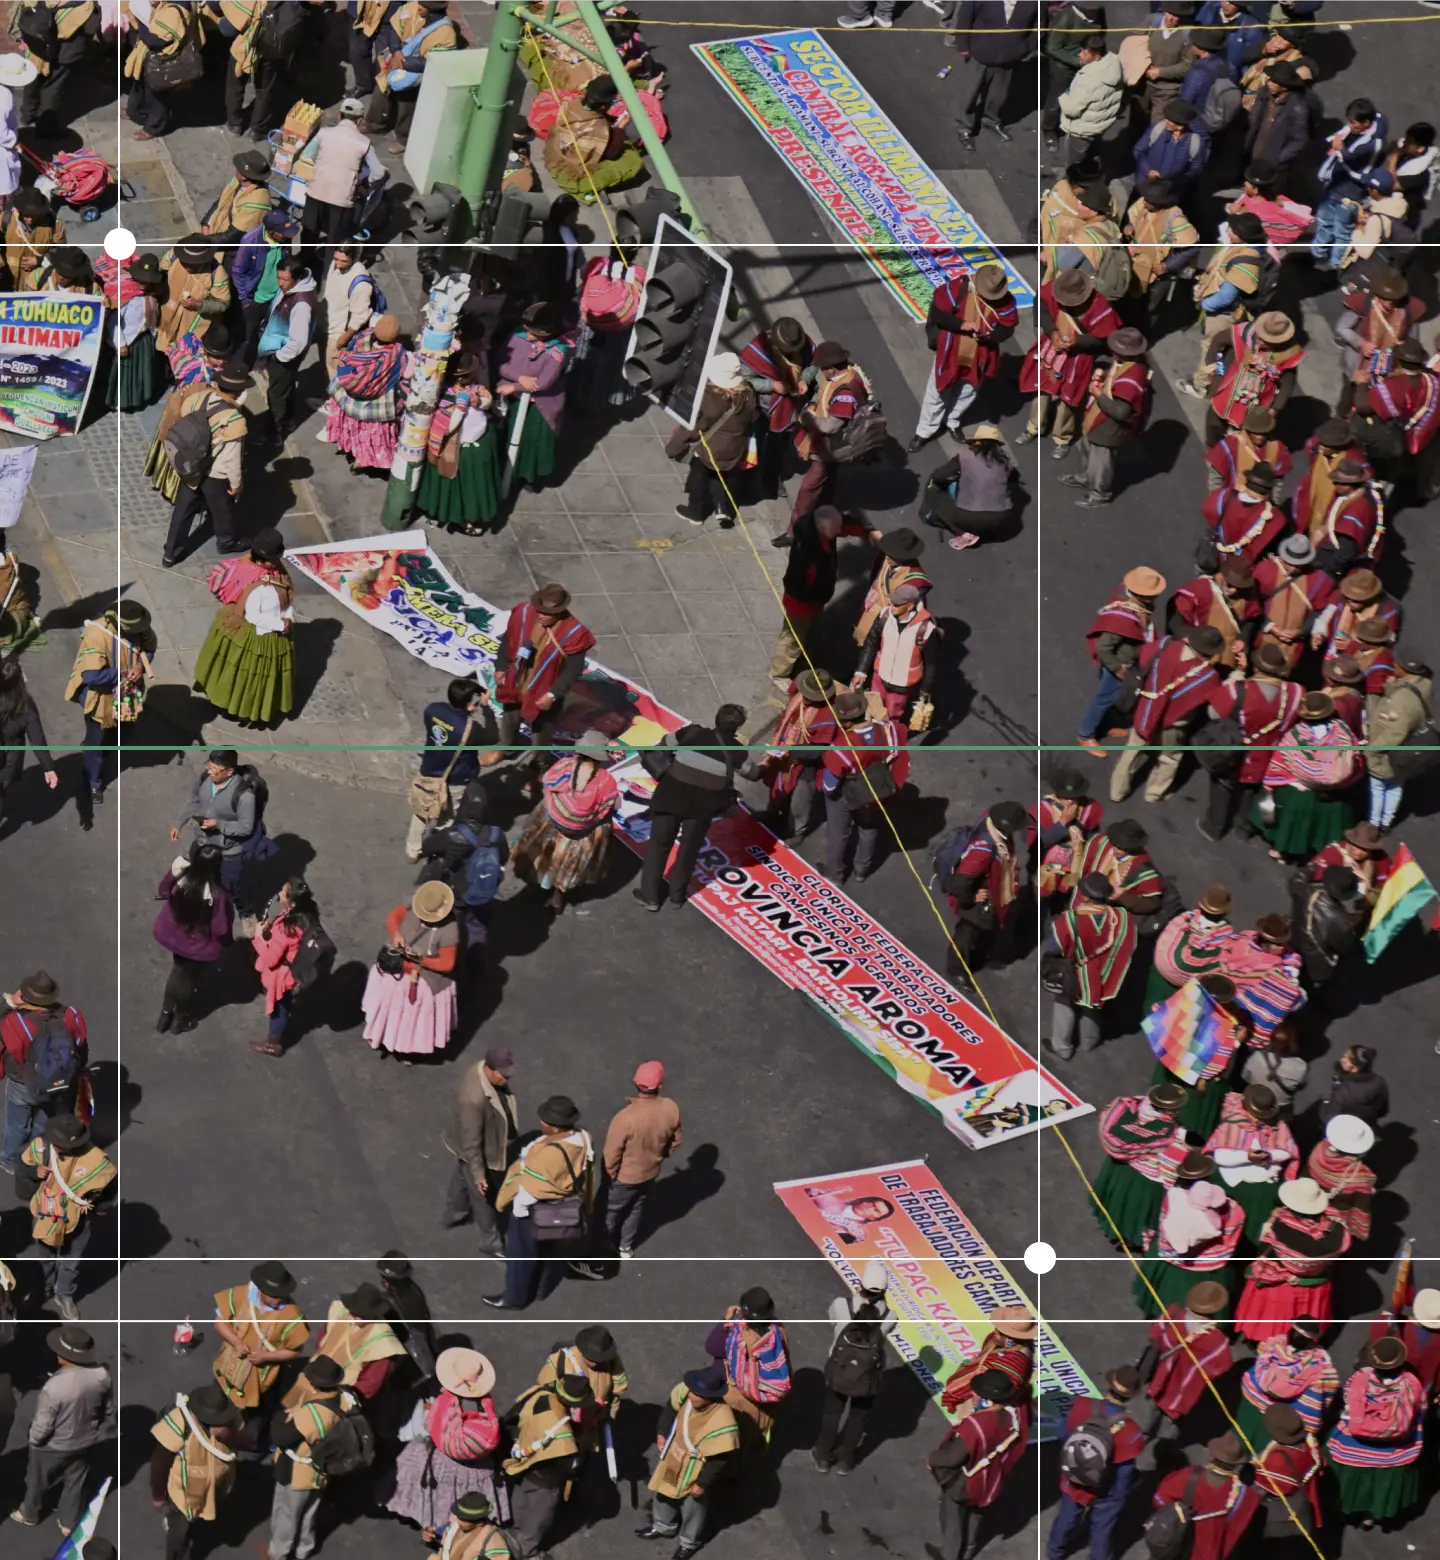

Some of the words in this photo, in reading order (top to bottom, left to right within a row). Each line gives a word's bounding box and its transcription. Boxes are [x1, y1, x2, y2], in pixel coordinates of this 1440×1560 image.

[766, 126, 874, 237] PRESENTE
[783, 70, 857, 142] CENTRAL
[842, 144, 918, 214] AGRARIA
[789, 40, 872, 116] SECTOR
[851, 117, 949, 205] ILLIMANI
[1, 326, 82, 348] ILLIMANI
[12, 299, 94, 326] TUHUACO
[43, 375, 68, 389] 2023
[698, 842, 852, 979] ROVINCIA
[845, 985, 972, 1086] AROMA
[735, 906, 793, 952] KATARI
[795, 958, 879, 1030] BARTOLINA
[746, 844, 811, 898] SINDICAL
[809, 898, 855, 936] UNICA
[851, 935, 876, 954] DE
[874, 952, 983, 1045] TRABAJADORES
[769, 882, 858, 956] CAMPESINOS
[854, 956, 928, 1016] AGRARIOS
[802, 874, 871, 932] GLORIOSA
[869, 931, 958, 1004] FEDERACION
[824, 1238, 864, 1291] “VOLVER
[880, 1174, 909, 1191] DE
[895, 1191, 975, 1280] TRABAJADORES
[1037, 1377, 1063, 1395] LA
[919, 1187, 987, 1257] FEDERACIÓN
